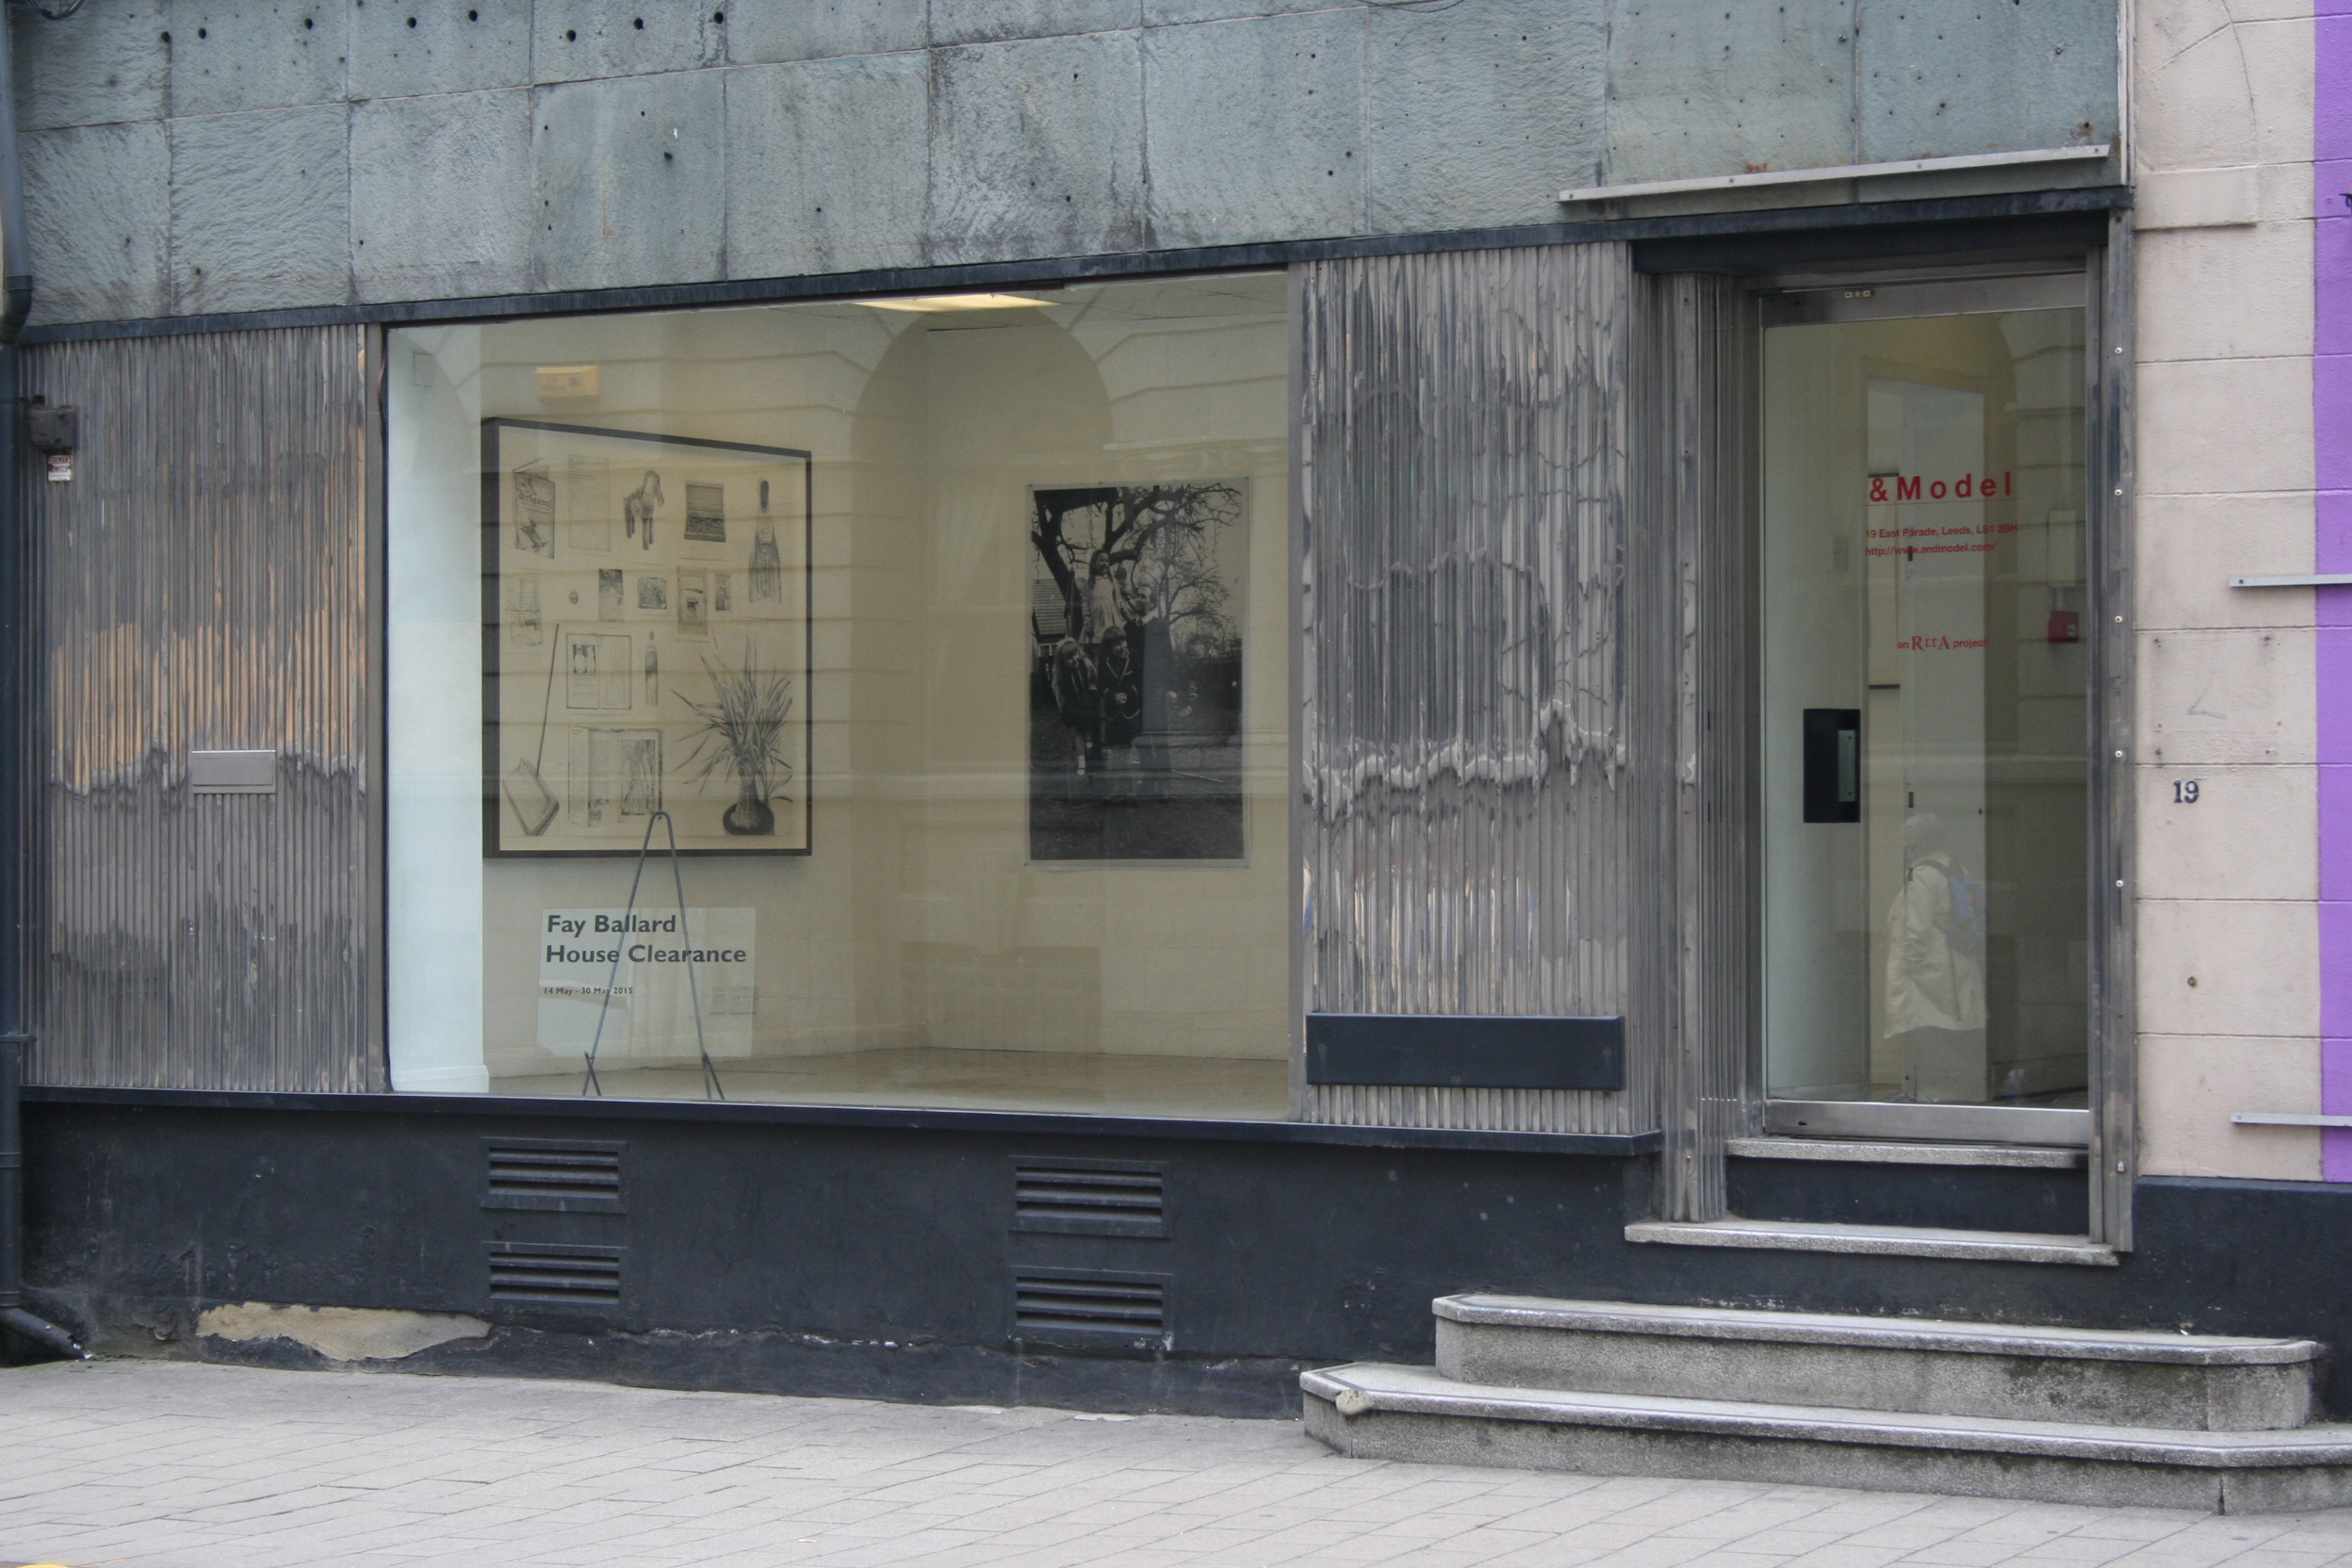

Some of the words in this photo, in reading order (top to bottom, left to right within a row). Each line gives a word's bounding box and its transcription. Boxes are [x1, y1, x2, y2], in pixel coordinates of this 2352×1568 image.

[1869, 471, 2012, 502] &Model
[1865, 530, 1876, 539] 19
[1879, 529, 1900, 538] East
[1903, 527, 1939, 537] Parade,
[1941, 526, 1973, 536] Leeds,
[1976, 525, 1994, 534] LS1
[1997, 523, 2018, 533] 2BH
[1865, 542, 1997, 557] http://www.andmodel.com/
[1952, 639, 1990, 649] project
[2173, 779, 2199, 804] 19
[547, 914, 586, 938] Fay
[594, 914, 677, 933] Ballard
[546, 944, 620, 963] House
[628, 944, 746, 963] Clearance
[556, 987, 573, 996] May
[594, 987, 612, 996] May
